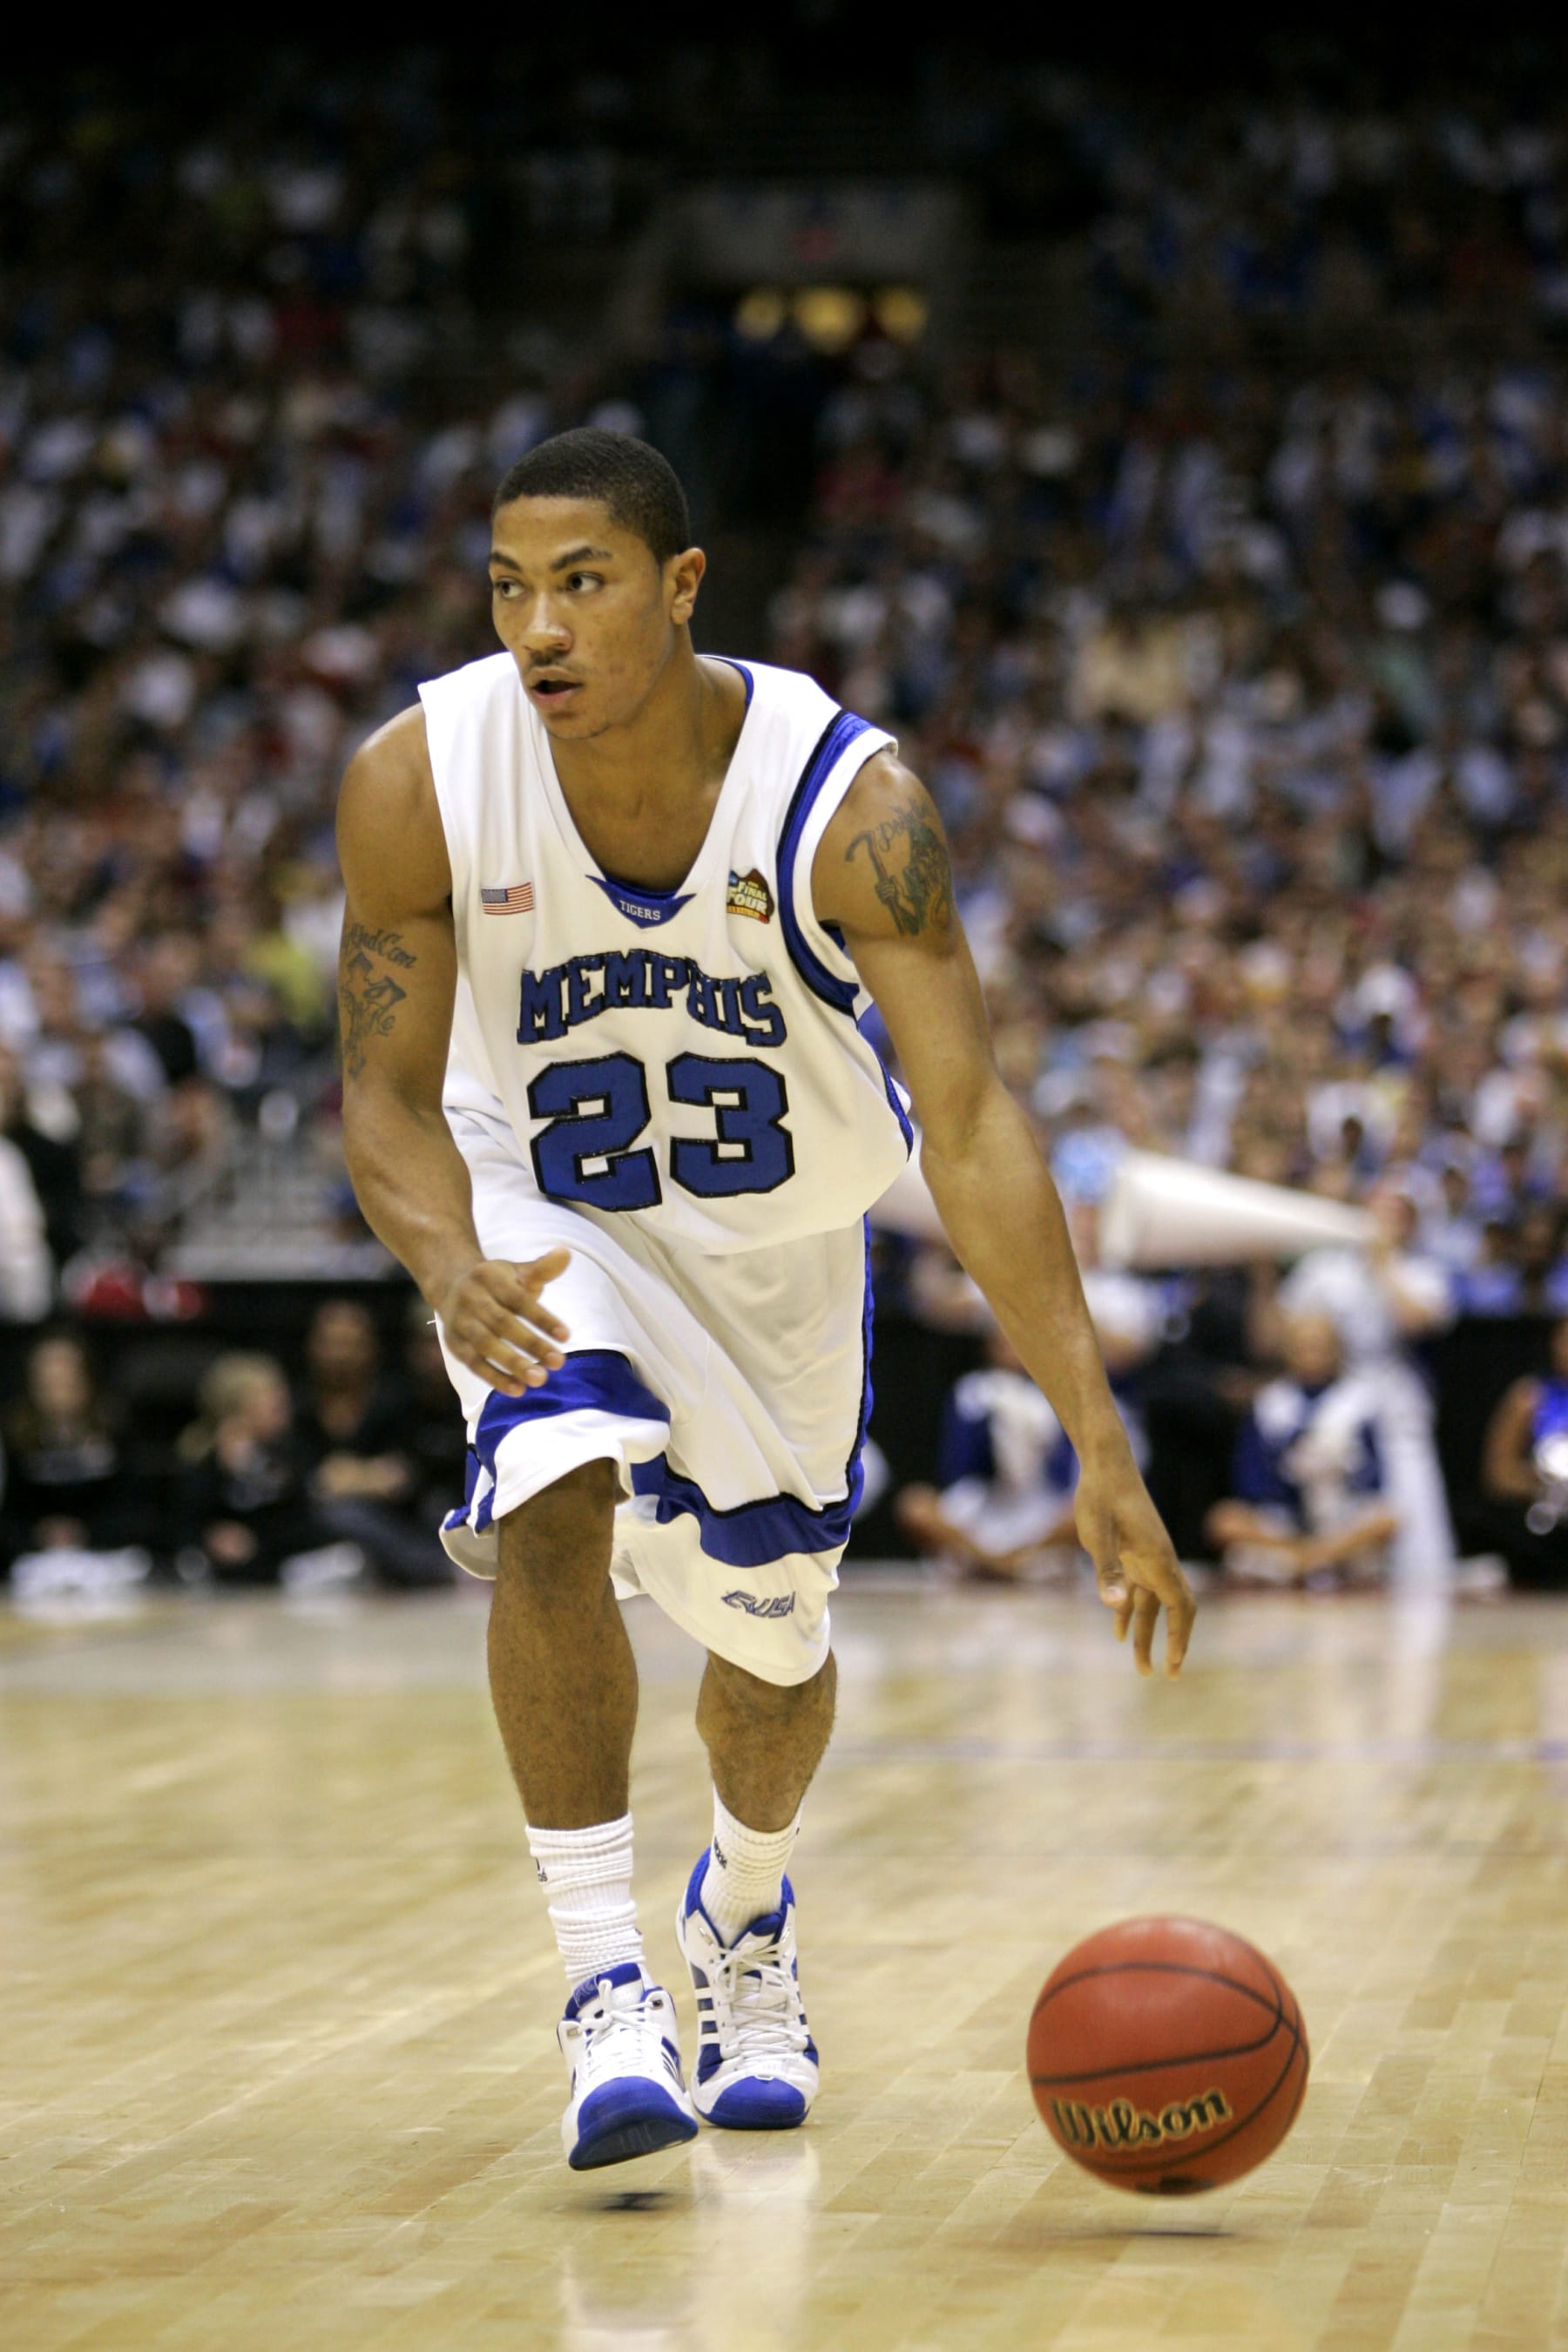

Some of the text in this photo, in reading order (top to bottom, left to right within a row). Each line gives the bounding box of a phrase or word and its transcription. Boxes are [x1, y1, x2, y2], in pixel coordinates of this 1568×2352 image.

[619, 900, 661, 921] TIGERS
[727, 887, 767, 915] FOUR
[738, 881, 767, 902] FINAL
[517, 949, 787, 1047] MEMPHIS
[526, 1051, 795, 1212] 23
[1049, 2086, 1233, 2150] Wilson
